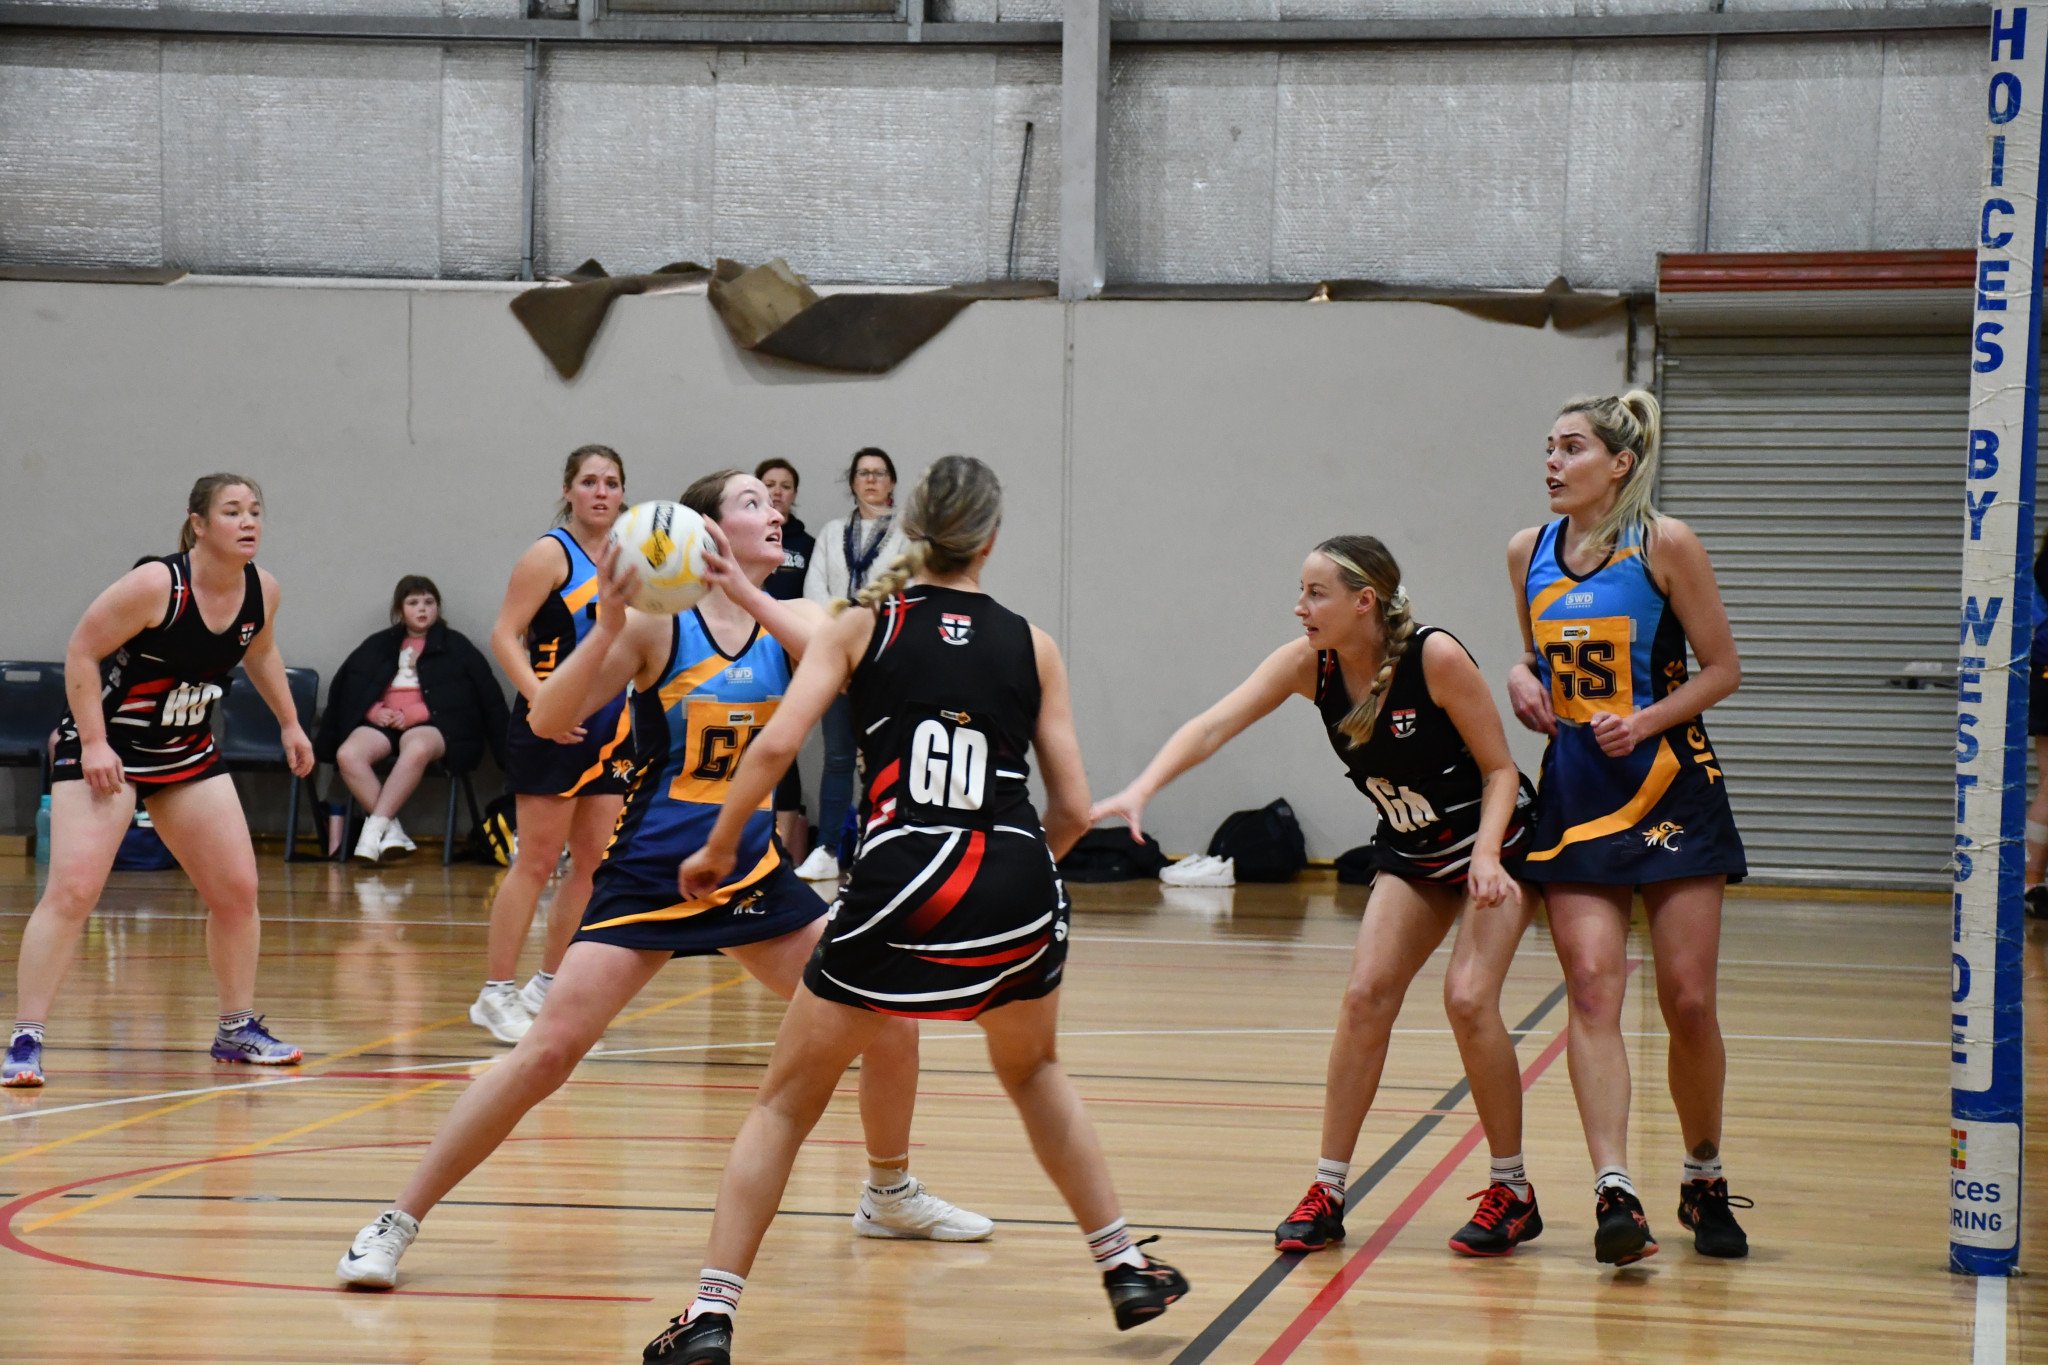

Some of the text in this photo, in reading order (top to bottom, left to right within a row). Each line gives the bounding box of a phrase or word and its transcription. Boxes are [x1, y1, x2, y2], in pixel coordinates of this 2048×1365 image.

[1966, 429, 1999, 541] BY
[1567, 594, 1592, 604] SWD
[1544, 640, 1617, 700] GS
[909, 719, 988, 811] GD
